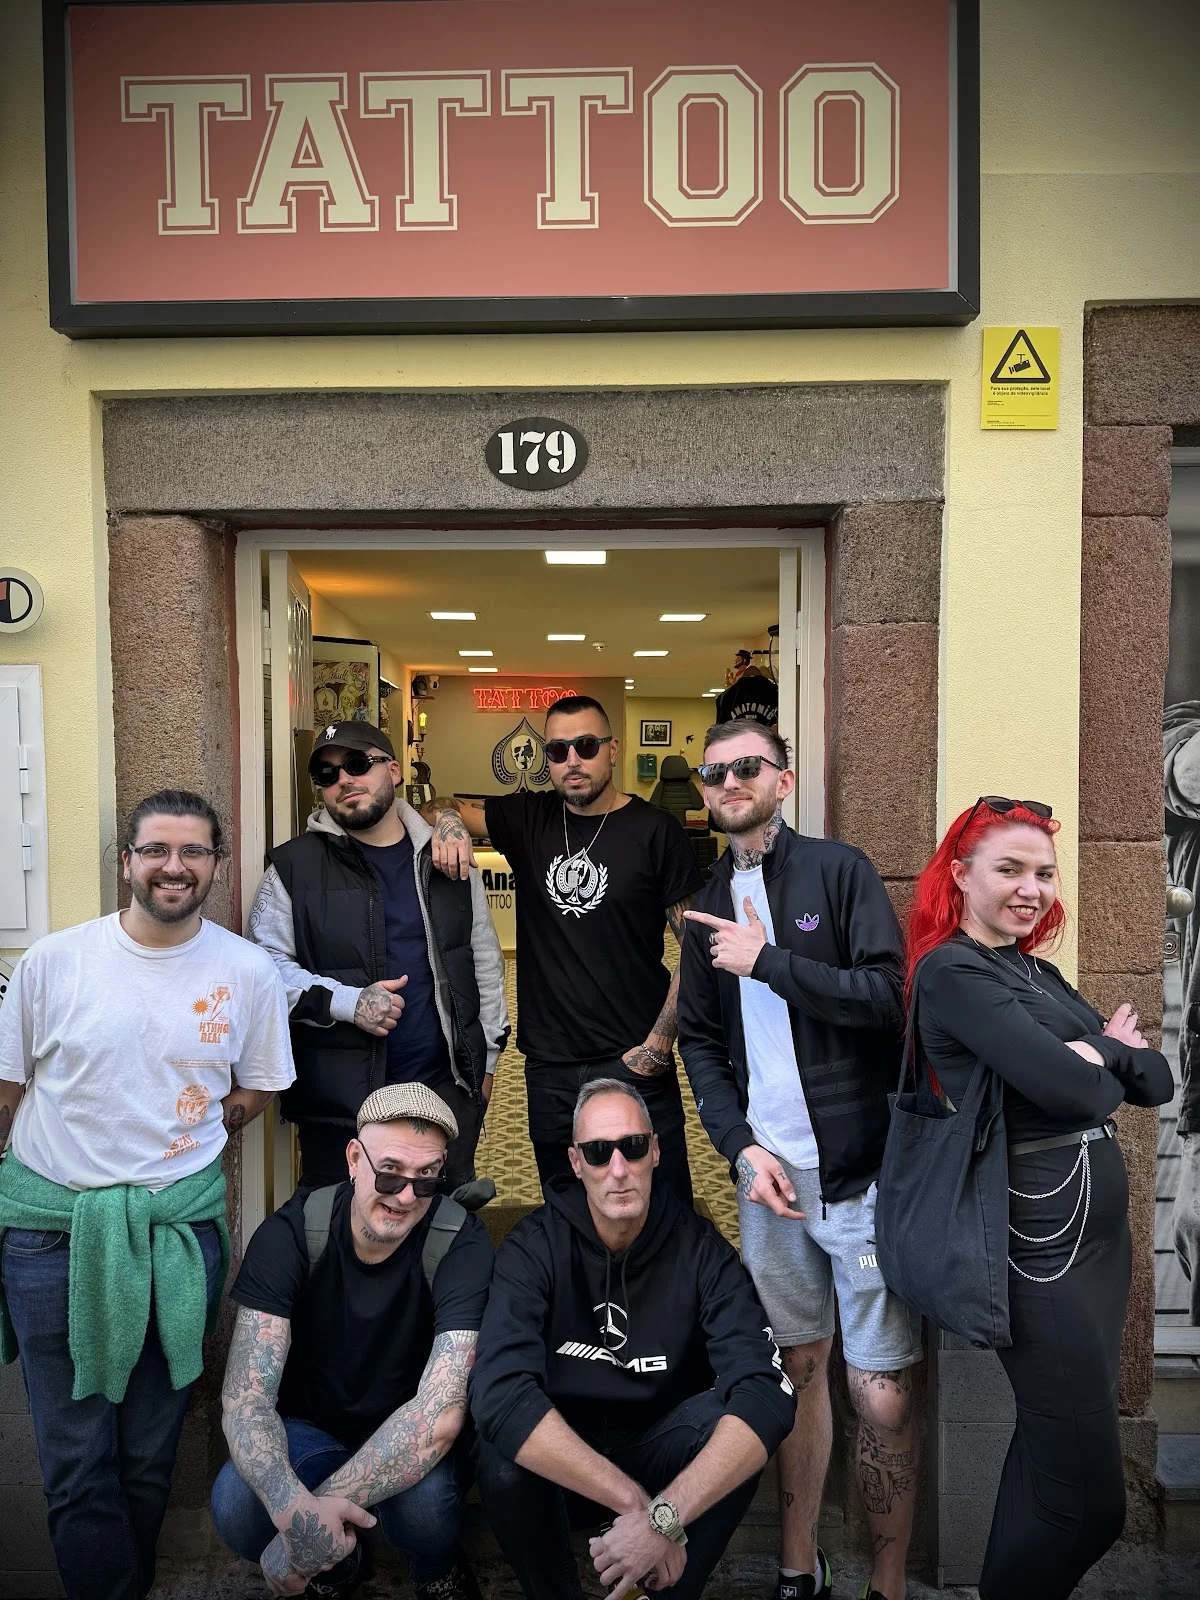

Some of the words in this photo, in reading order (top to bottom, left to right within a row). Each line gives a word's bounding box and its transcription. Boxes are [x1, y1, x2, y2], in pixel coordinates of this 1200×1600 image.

[120, 62, 901, 236] TATTOO
[497, 430, 577, 475] 179
[482, 868, 516, 891] Ana
[486, 893, 513, 910] TTOO
[858, 1253, 878, 1270] PU
